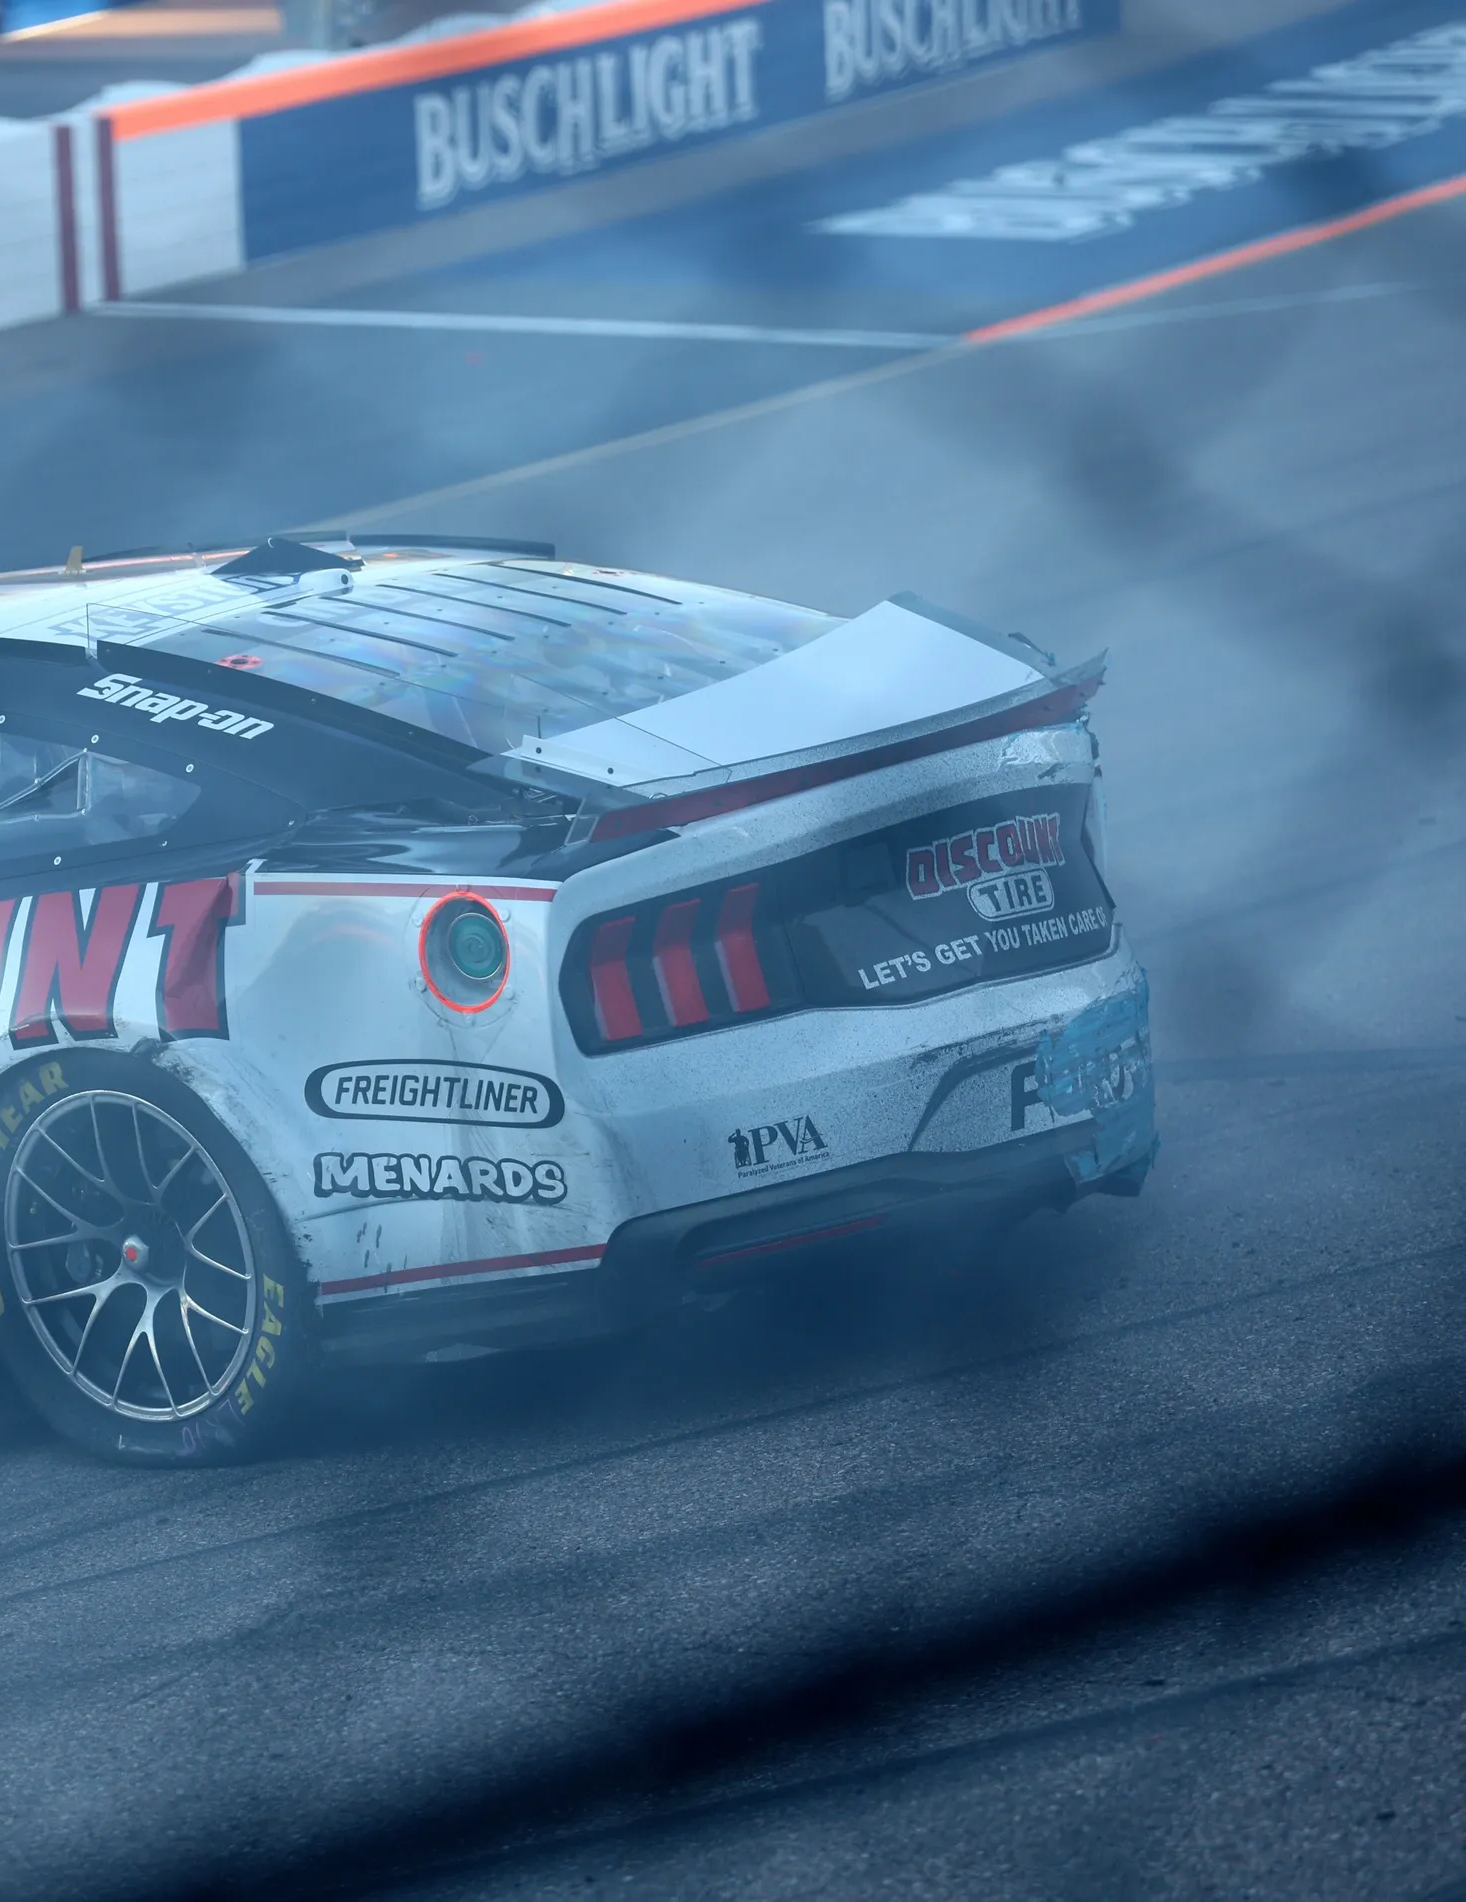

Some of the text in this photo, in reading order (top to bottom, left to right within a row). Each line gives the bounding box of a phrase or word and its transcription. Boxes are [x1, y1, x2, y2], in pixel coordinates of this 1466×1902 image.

[825, 0, 1083, 103] BUSCHLI
[413, 17, 764, 211] BUSCHLIGHT
[76, 673, 274, 739] Snap-on
[906, 812, 1065, 900] DISCOUNT
[978, 874, 1048, 913] TIRE
[858, 950, 932, 990] LET'S
[934, 935, 983, 965] GET
[986, 926, 1020, 952] YOU
[1021, 919, 1069, 946] TAKEN
[1069, 908, 1099, 935] CARE
[335, 1074, 539, 1114] FREIGHTLINER
[737, 1165, 769, 1179] Paralyzed
[769, 1160, 797, 1171] Veterans
[804, 1152, 830, 1162] America
[747, 1115, 829, 1165] PVA
[313, 1152, 568, 1206] MENARDS
[234, 1273, 284, 1415] EAGLE
